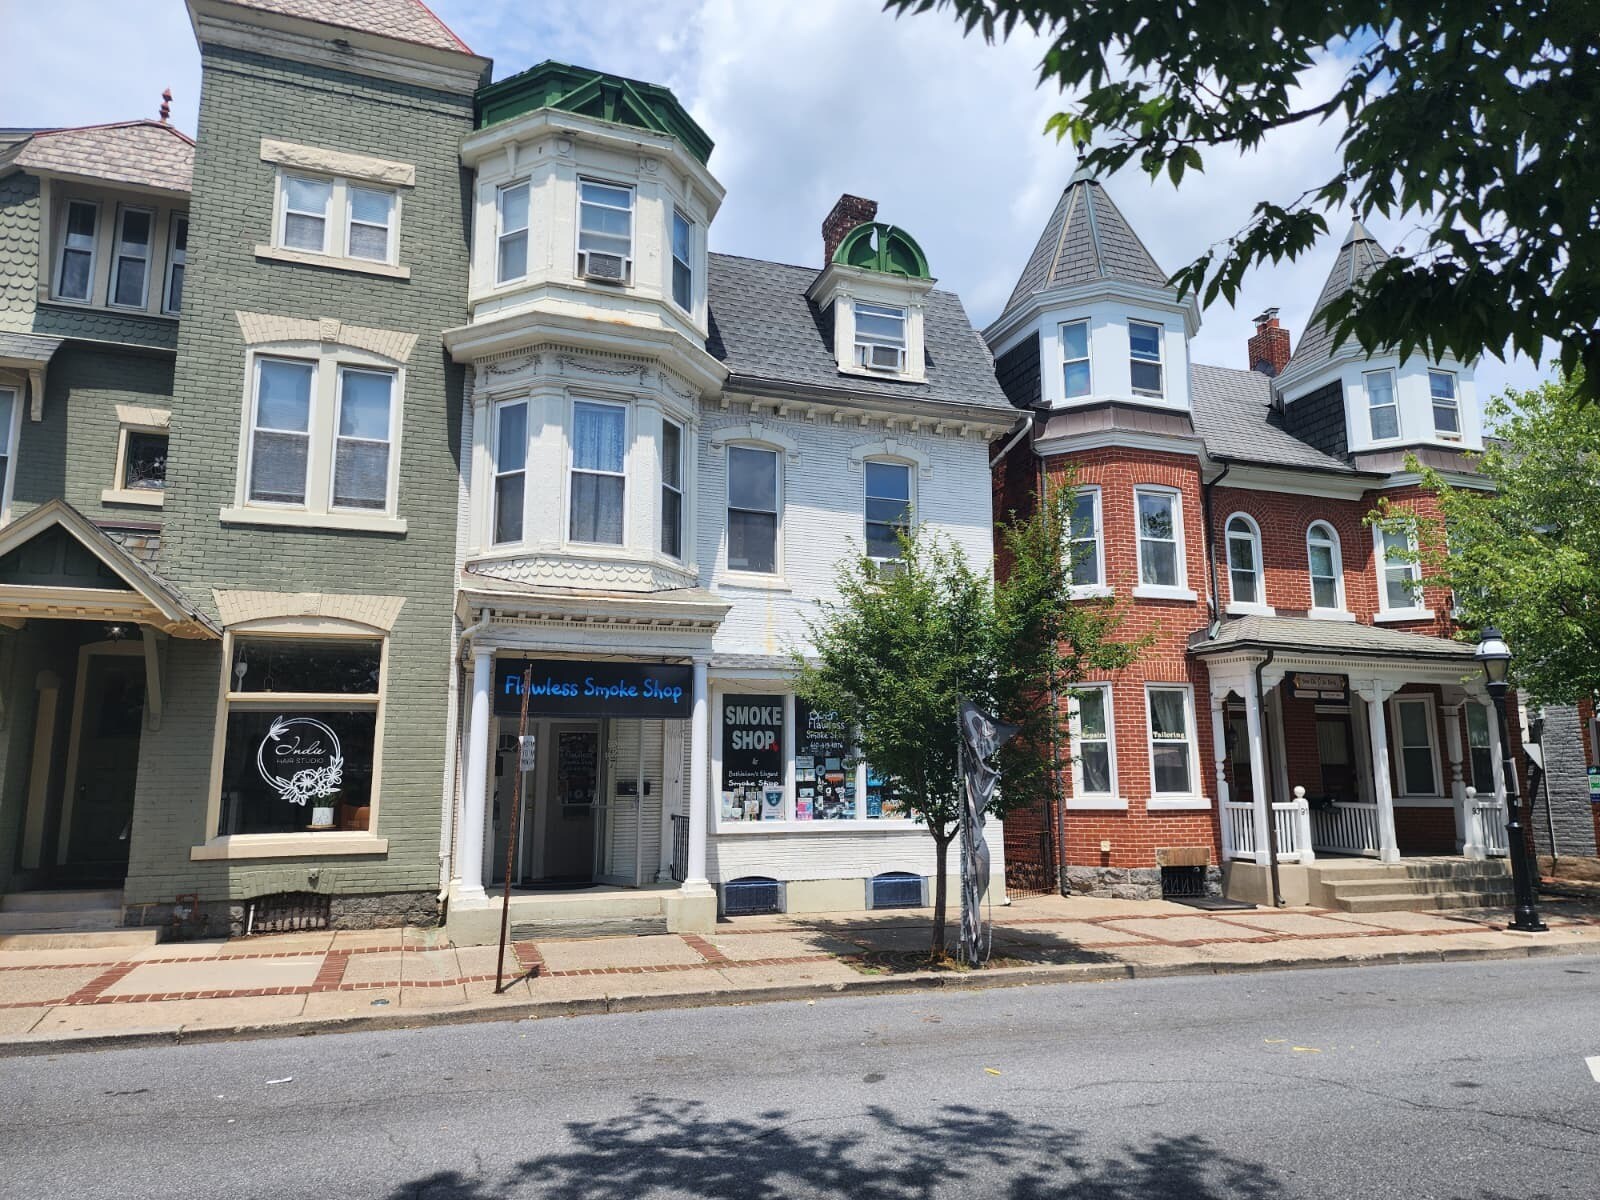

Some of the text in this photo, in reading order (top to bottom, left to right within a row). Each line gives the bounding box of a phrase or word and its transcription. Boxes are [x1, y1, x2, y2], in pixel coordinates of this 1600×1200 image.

[584, 677, 638, 700] Smoke
[643, 678, 682, 704] Shop
[726, 706, 782, 725] SMOKE
[732, 730, 775, 750] SHOP
[1152, 731, 1186, 739] Tailoring
[275, 736, 326, 755] Indie
[728, 779, 780, 788] Smoke Shop
